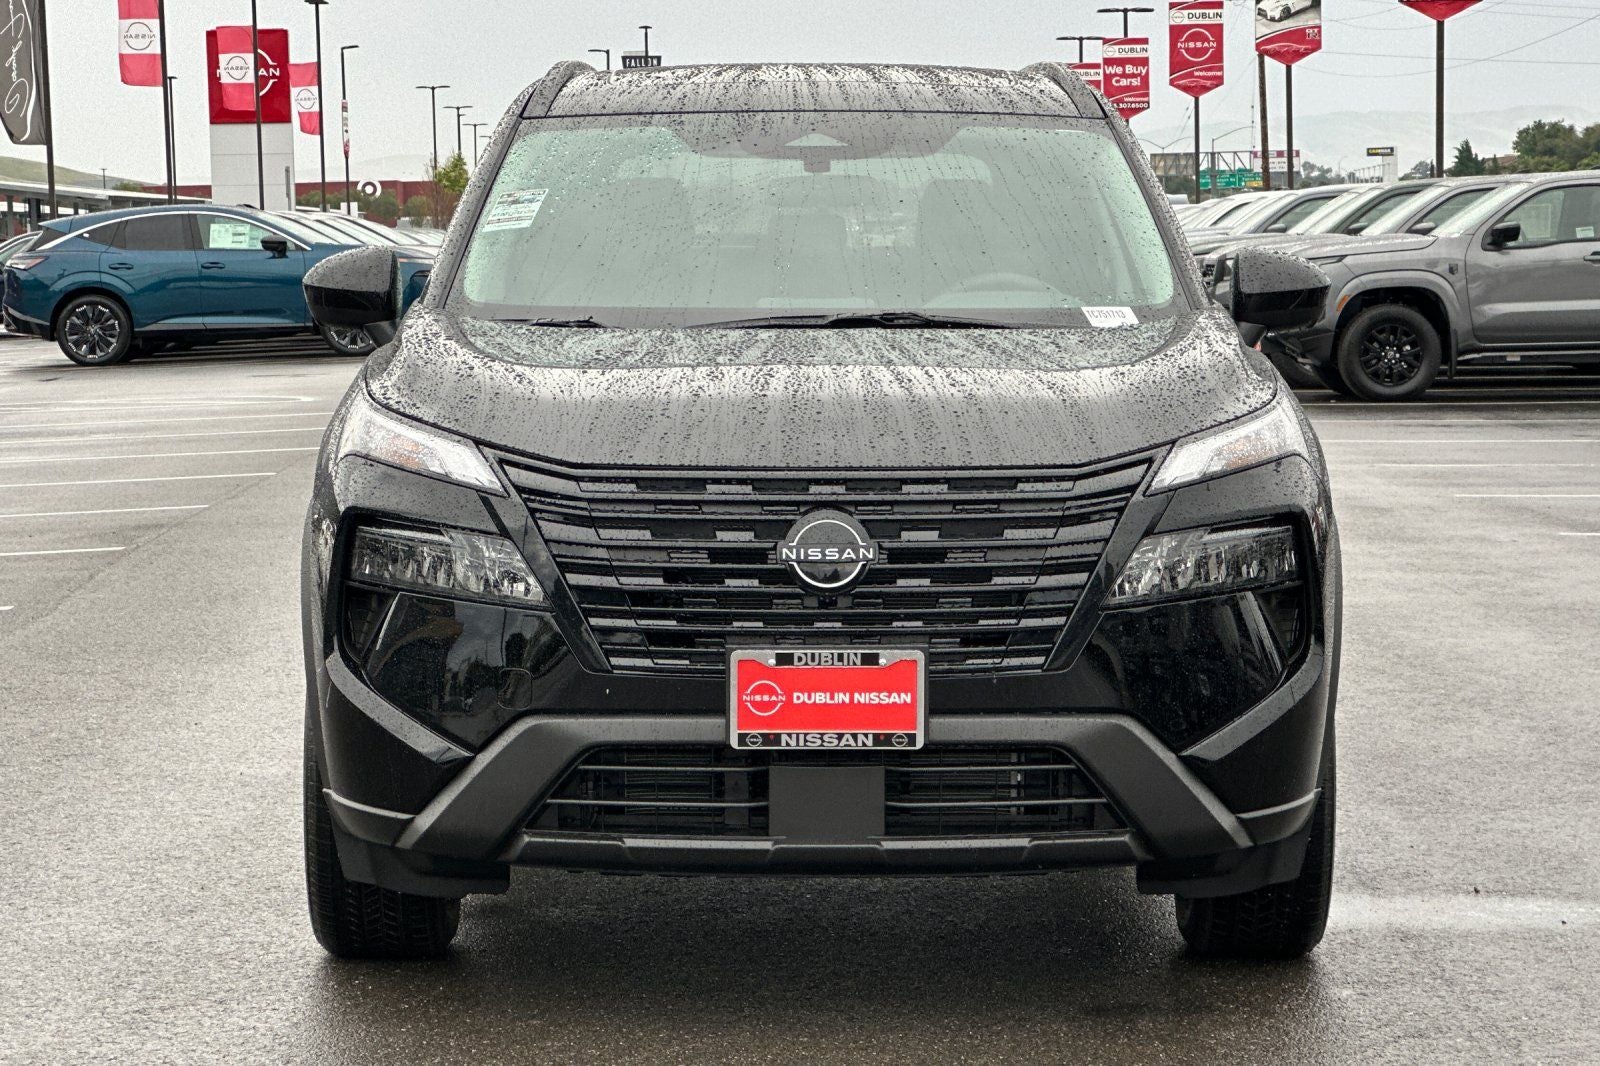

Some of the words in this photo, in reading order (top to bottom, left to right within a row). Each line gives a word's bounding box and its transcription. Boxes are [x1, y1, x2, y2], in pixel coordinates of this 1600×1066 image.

[1187, 12, 1222, 20] DUBLIN
[1177, 41, 1216, 49] NISSAN
[1104, 64, 1123, 75] We
[1125, 64, 1148, 76] Buy
[1112, 76, 1141, 87] Cars!
[782, 548, 873, 560] NISSAN
[794, 652, 862, 667] DUBLIN
[742, 694, 786, 702] NISSAN
[793, 691, 850, 705] DUBLIN
[853, 691, 912, 705] NISSAN
[781, 733, 873, 747] NISSAN
